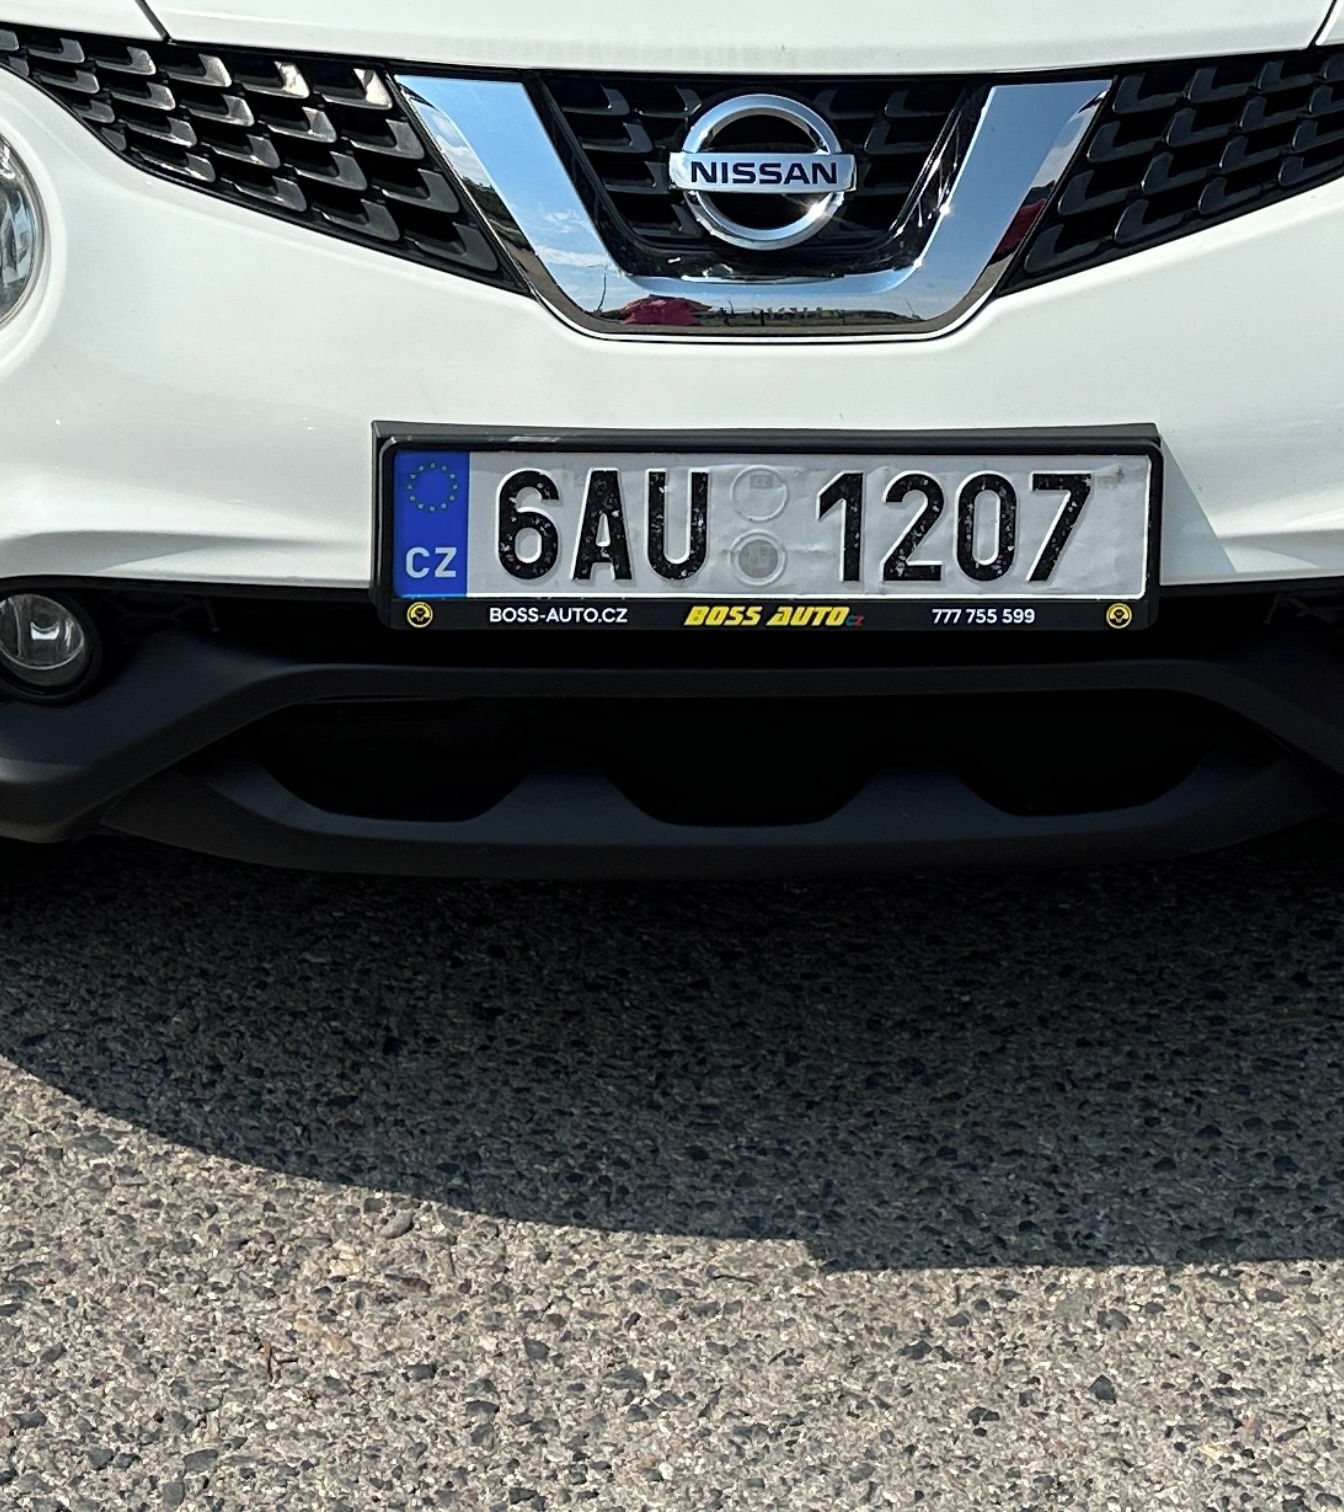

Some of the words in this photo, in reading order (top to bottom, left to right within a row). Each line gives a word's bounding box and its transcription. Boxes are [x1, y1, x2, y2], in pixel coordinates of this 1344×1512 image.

[690, 160, 839, 185] NISSAN
[498, 470, 709, 581] 6AU
[818, 472, 1092, 583] 1207
[406, 546, 457, 579] CZ
[489, 607, 628, 623] BOSS-AUTO.CZ
[683, 605, 763, 626] BOSS
[932, 608, 961, 623] 777
[965, 608, 997, 623] 755
[1002, 608, 1035, 624] 599
